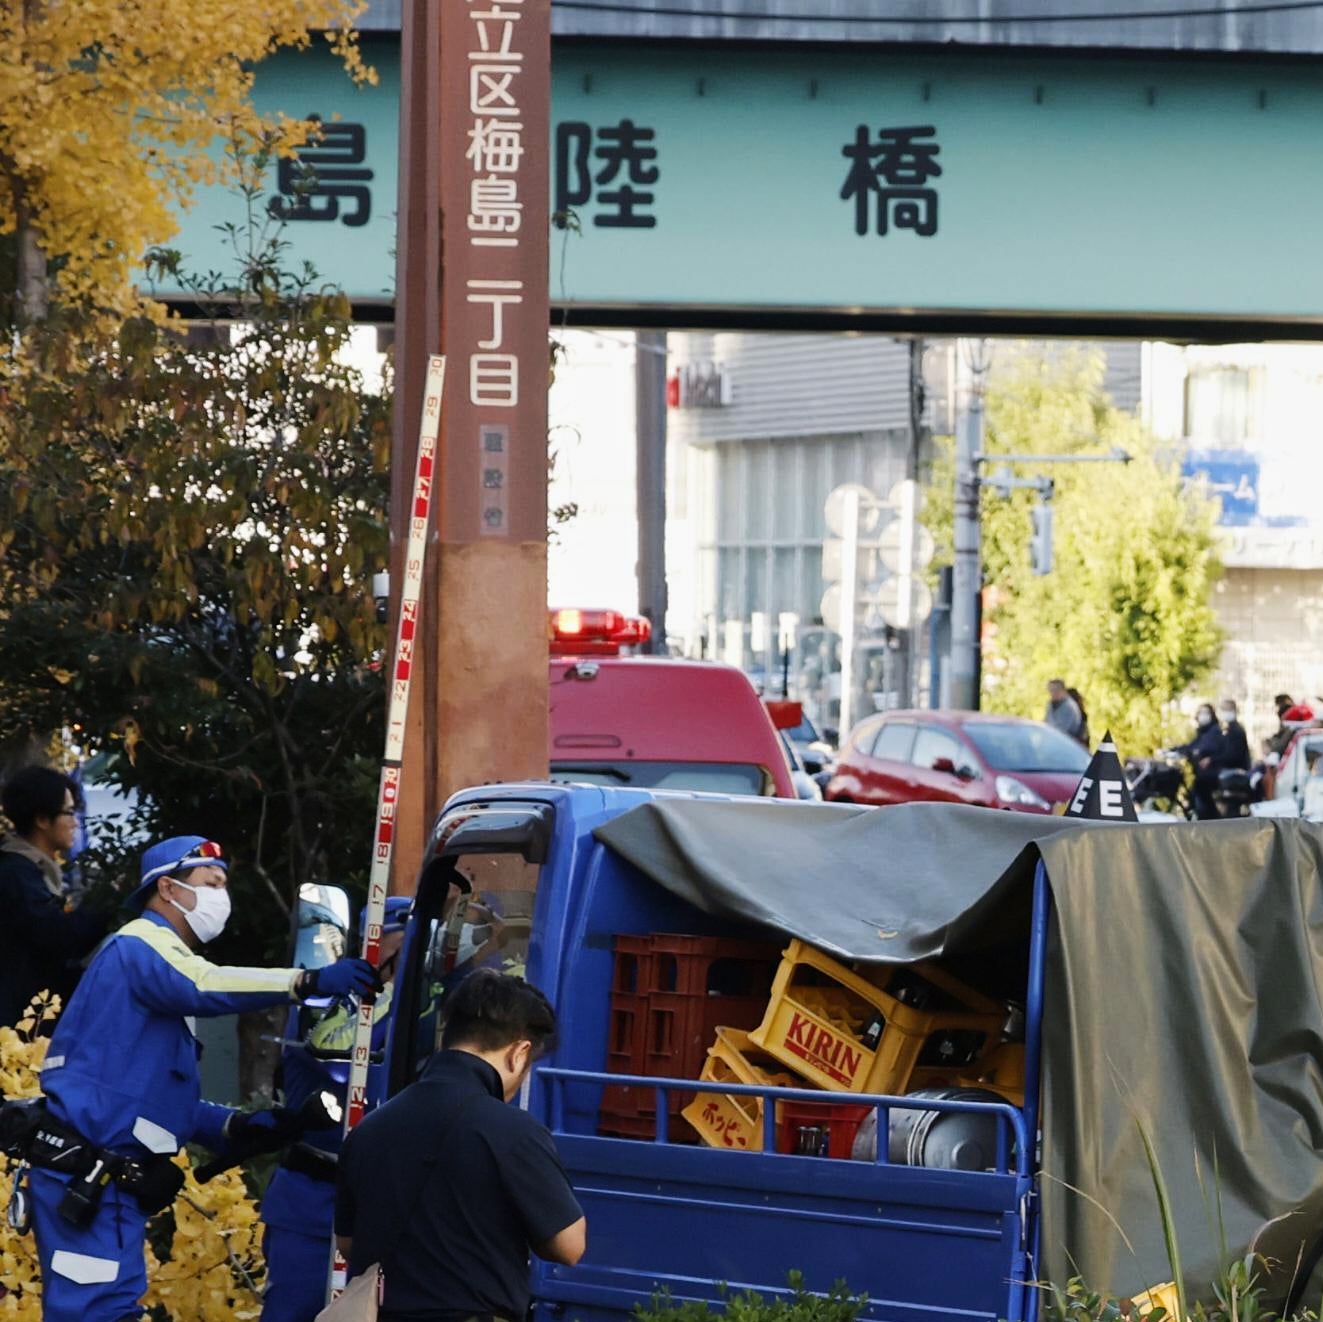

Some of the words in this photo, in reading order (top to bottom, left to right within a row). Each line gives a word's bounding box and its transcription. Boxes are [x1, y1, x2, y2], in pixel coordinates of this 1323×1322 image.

[466, 0, 524, 406] 立区梅島二丁目
[786, 1011, 862, 1078] KIRIN
[702, 1102, 747, 1147] ホッピー
